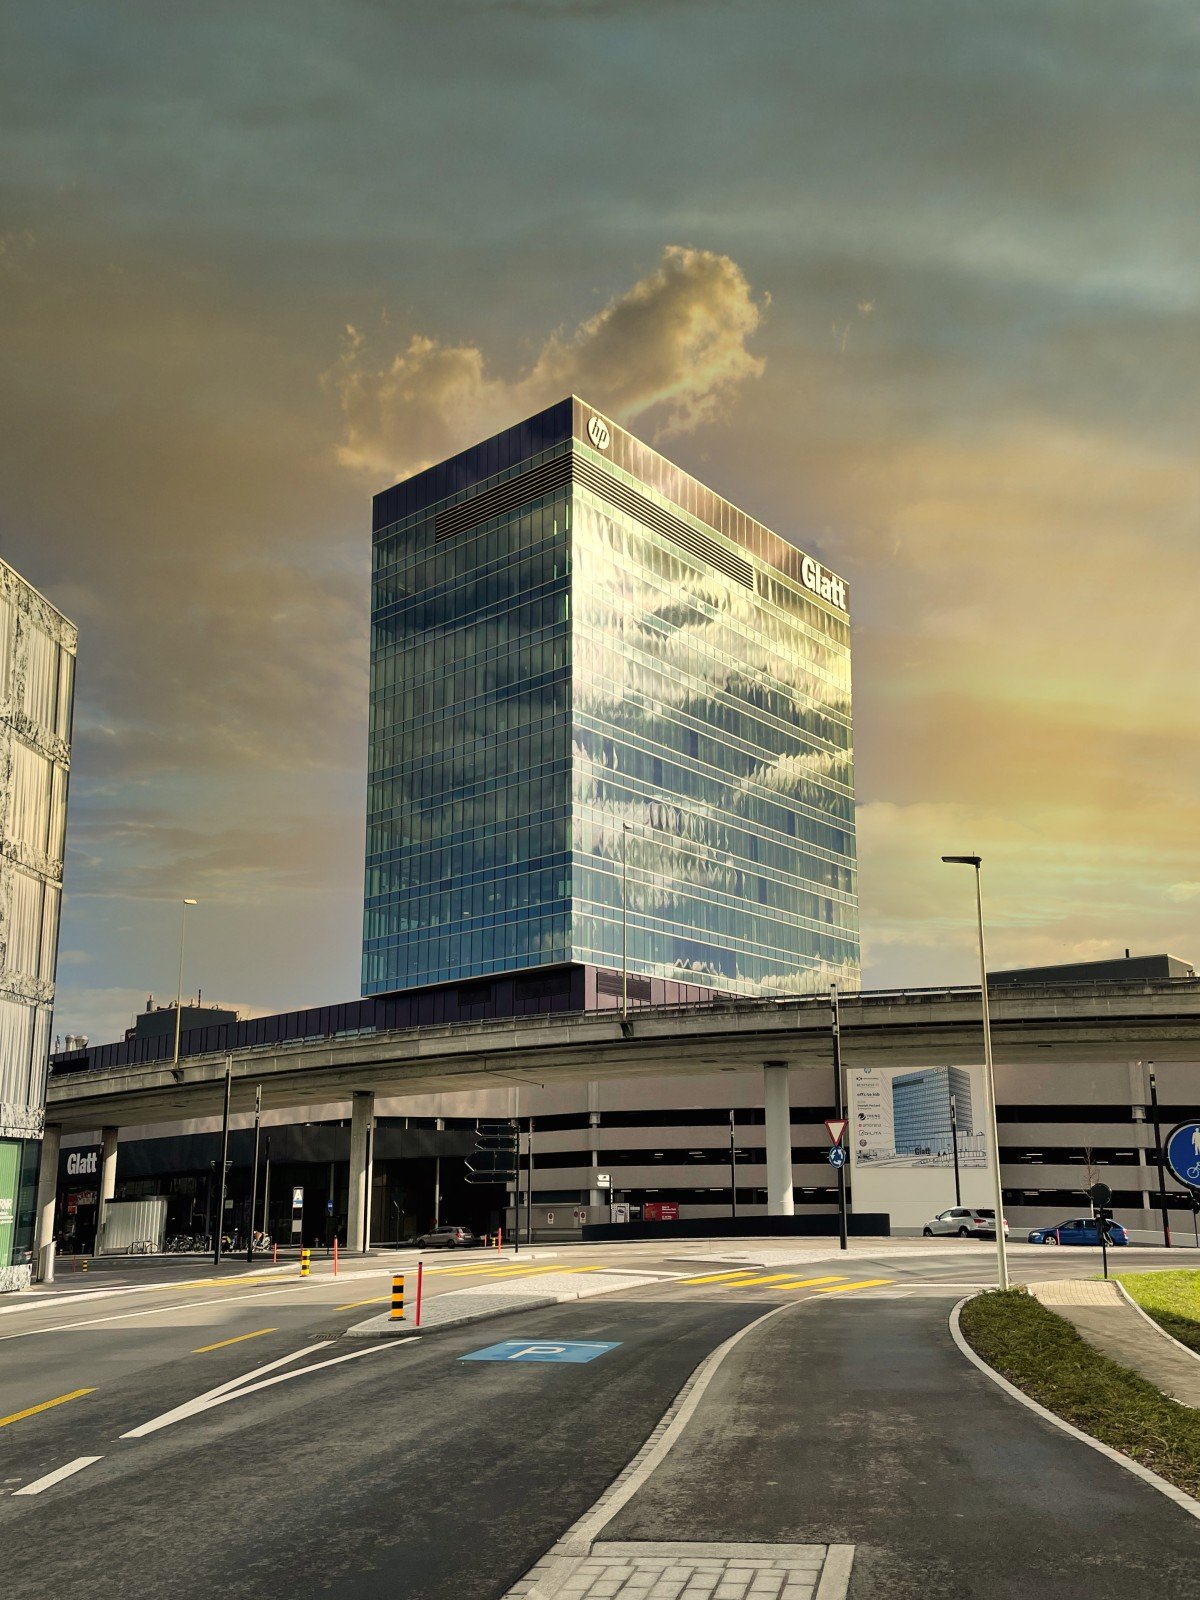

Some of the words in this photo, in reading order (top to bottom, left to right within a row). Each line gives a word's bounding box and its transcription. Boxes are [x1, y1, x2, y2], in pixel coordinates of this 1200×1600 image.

[801, 556, 846, 611] Glatt
[914, 1147, 931, 1155] Glatt
[67, 1152, 97, 1175] Glatt
